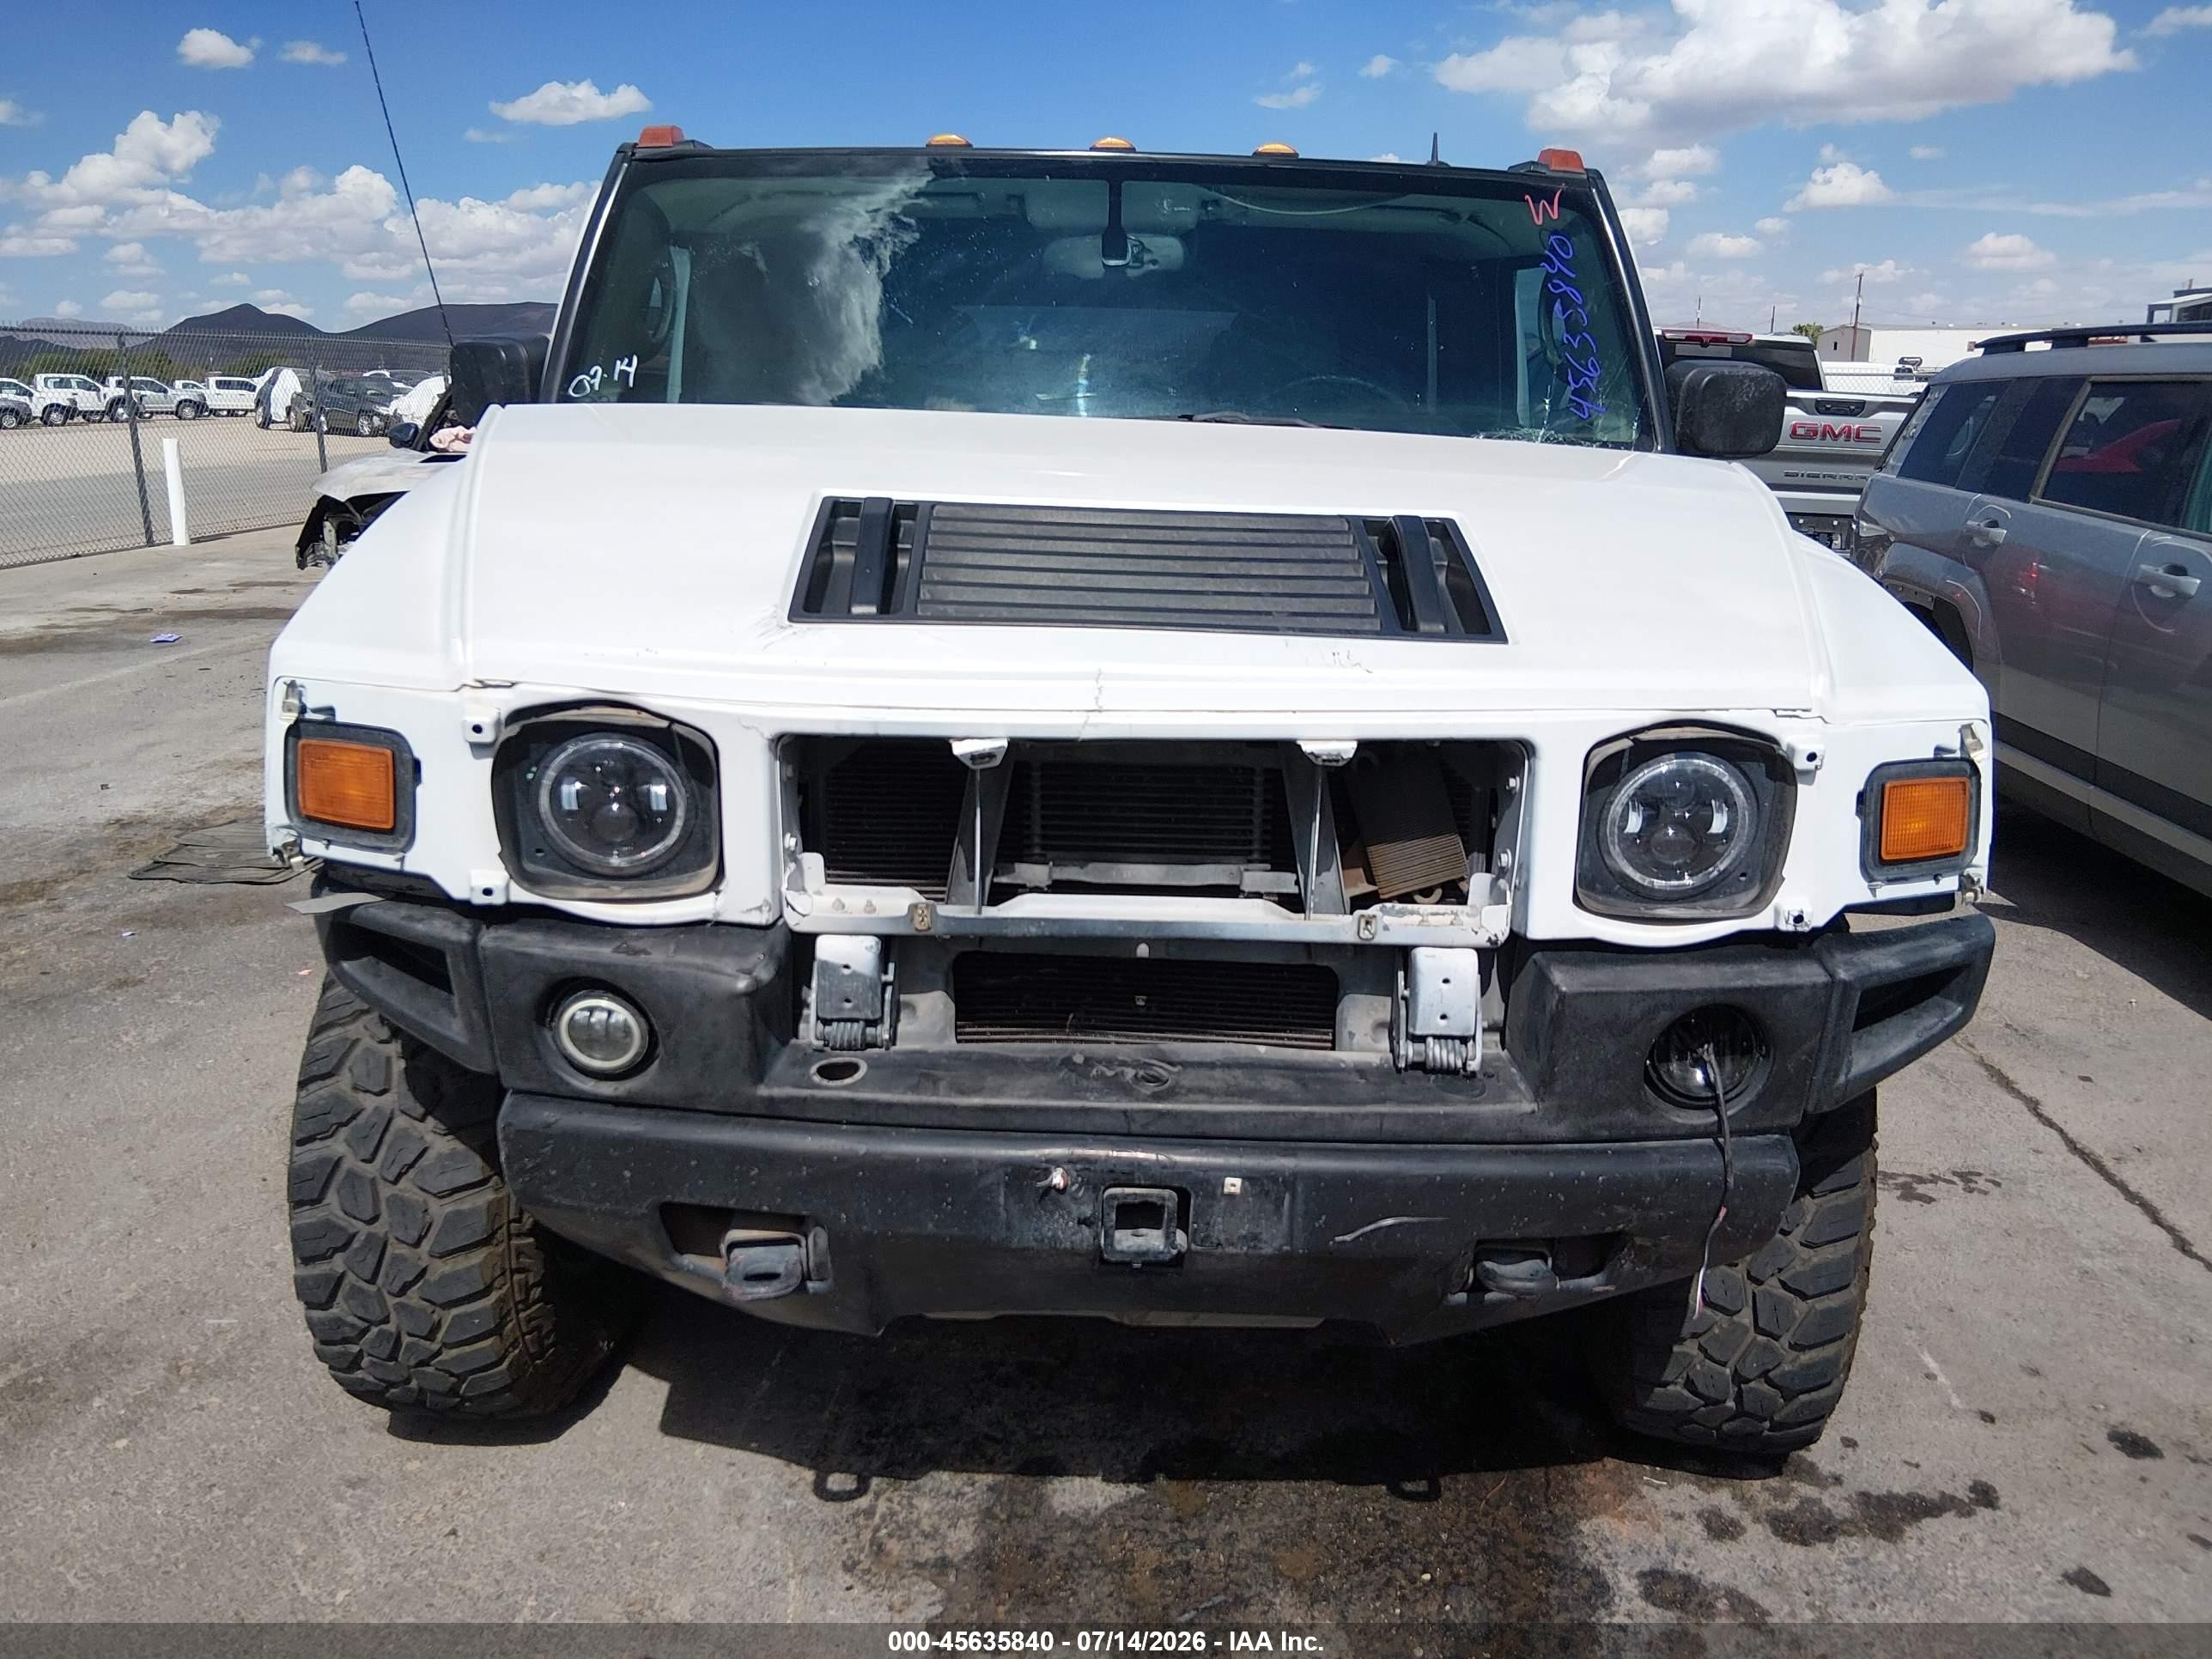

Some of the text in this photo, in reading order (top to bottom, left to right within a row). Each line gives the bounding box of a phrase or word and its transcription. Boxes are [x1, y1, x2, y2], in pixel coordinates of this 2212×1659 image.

[1524, 183, 1566, 226] W
[1540, 234, 1607, 420] 45635840
[1790, 421, 1882, 443] GMC
[1784, 470, 1869, 482] SIERRA
